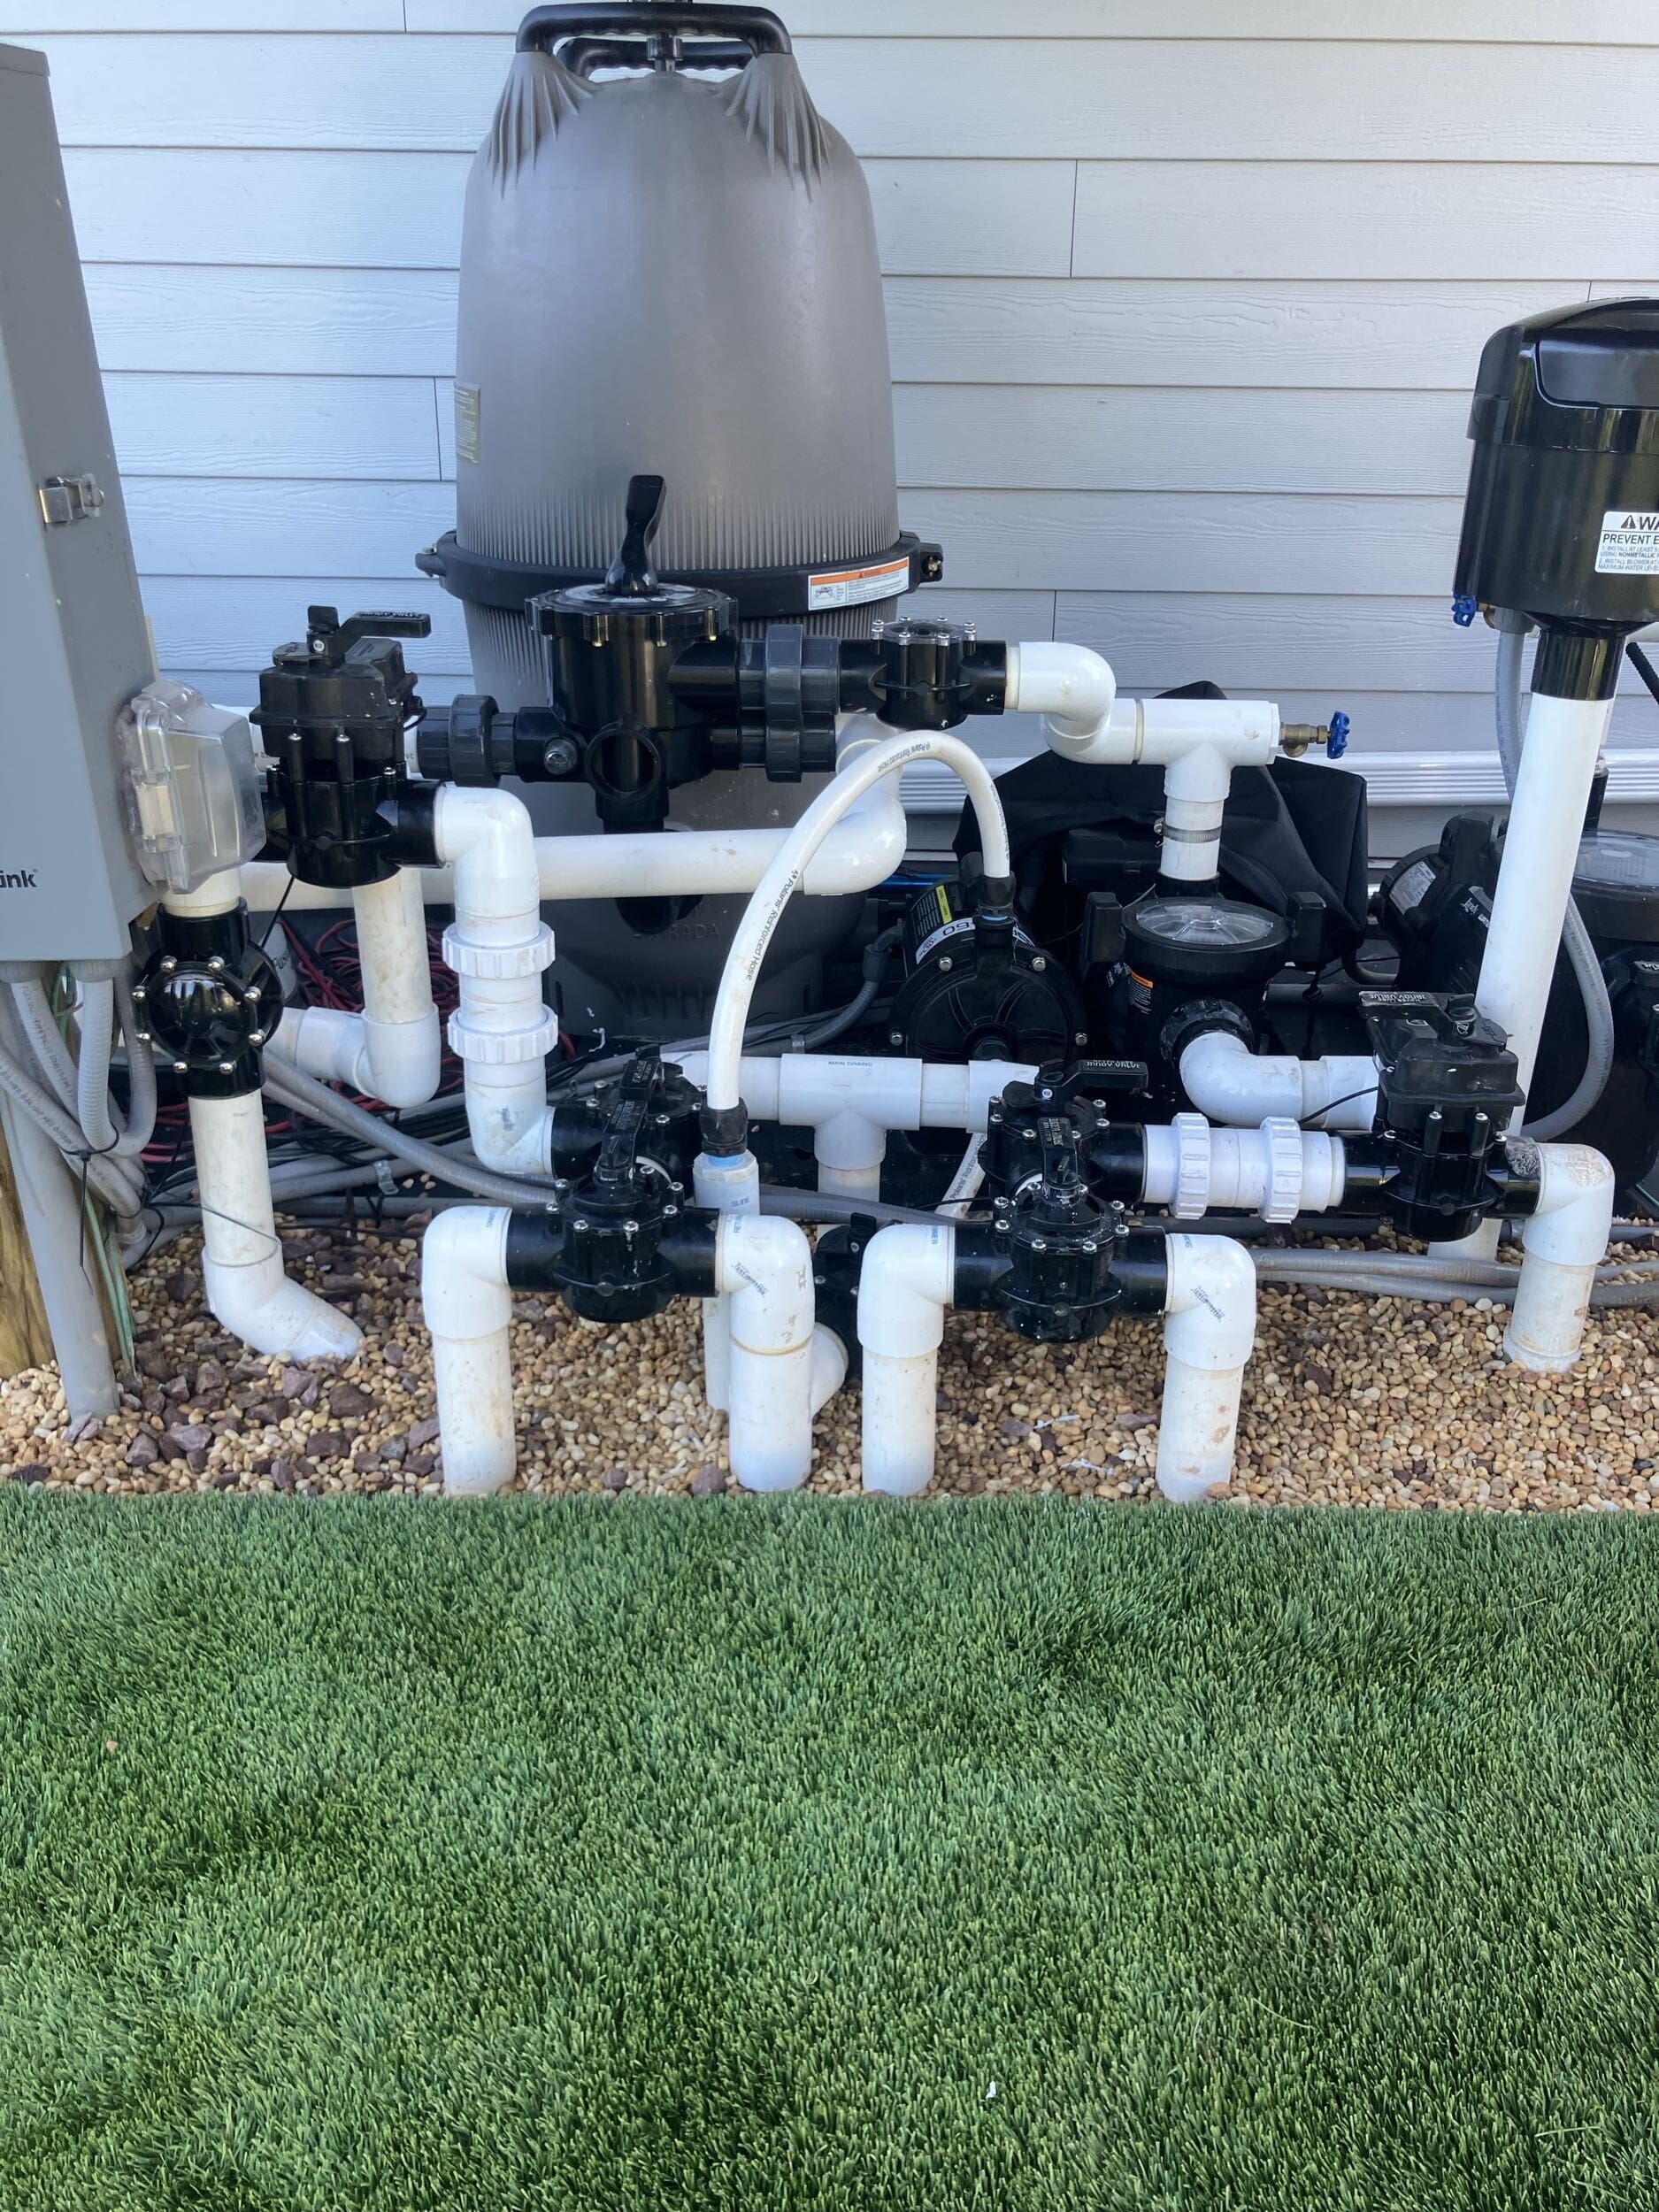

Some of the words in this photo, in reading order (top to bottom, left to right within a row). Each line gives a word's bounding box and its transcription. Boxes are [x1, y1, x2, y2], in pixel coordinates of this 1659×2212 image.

[1602, 534, 1652, 545] PREVENT
[0, 870, 37, 888] ink
[774, 878, 795, 908] Polaris
[754, 910, 779, 957] Reinforced
[746, 956, 761, 981] Hose
[949, 1178, 967, 1200] Polaris
